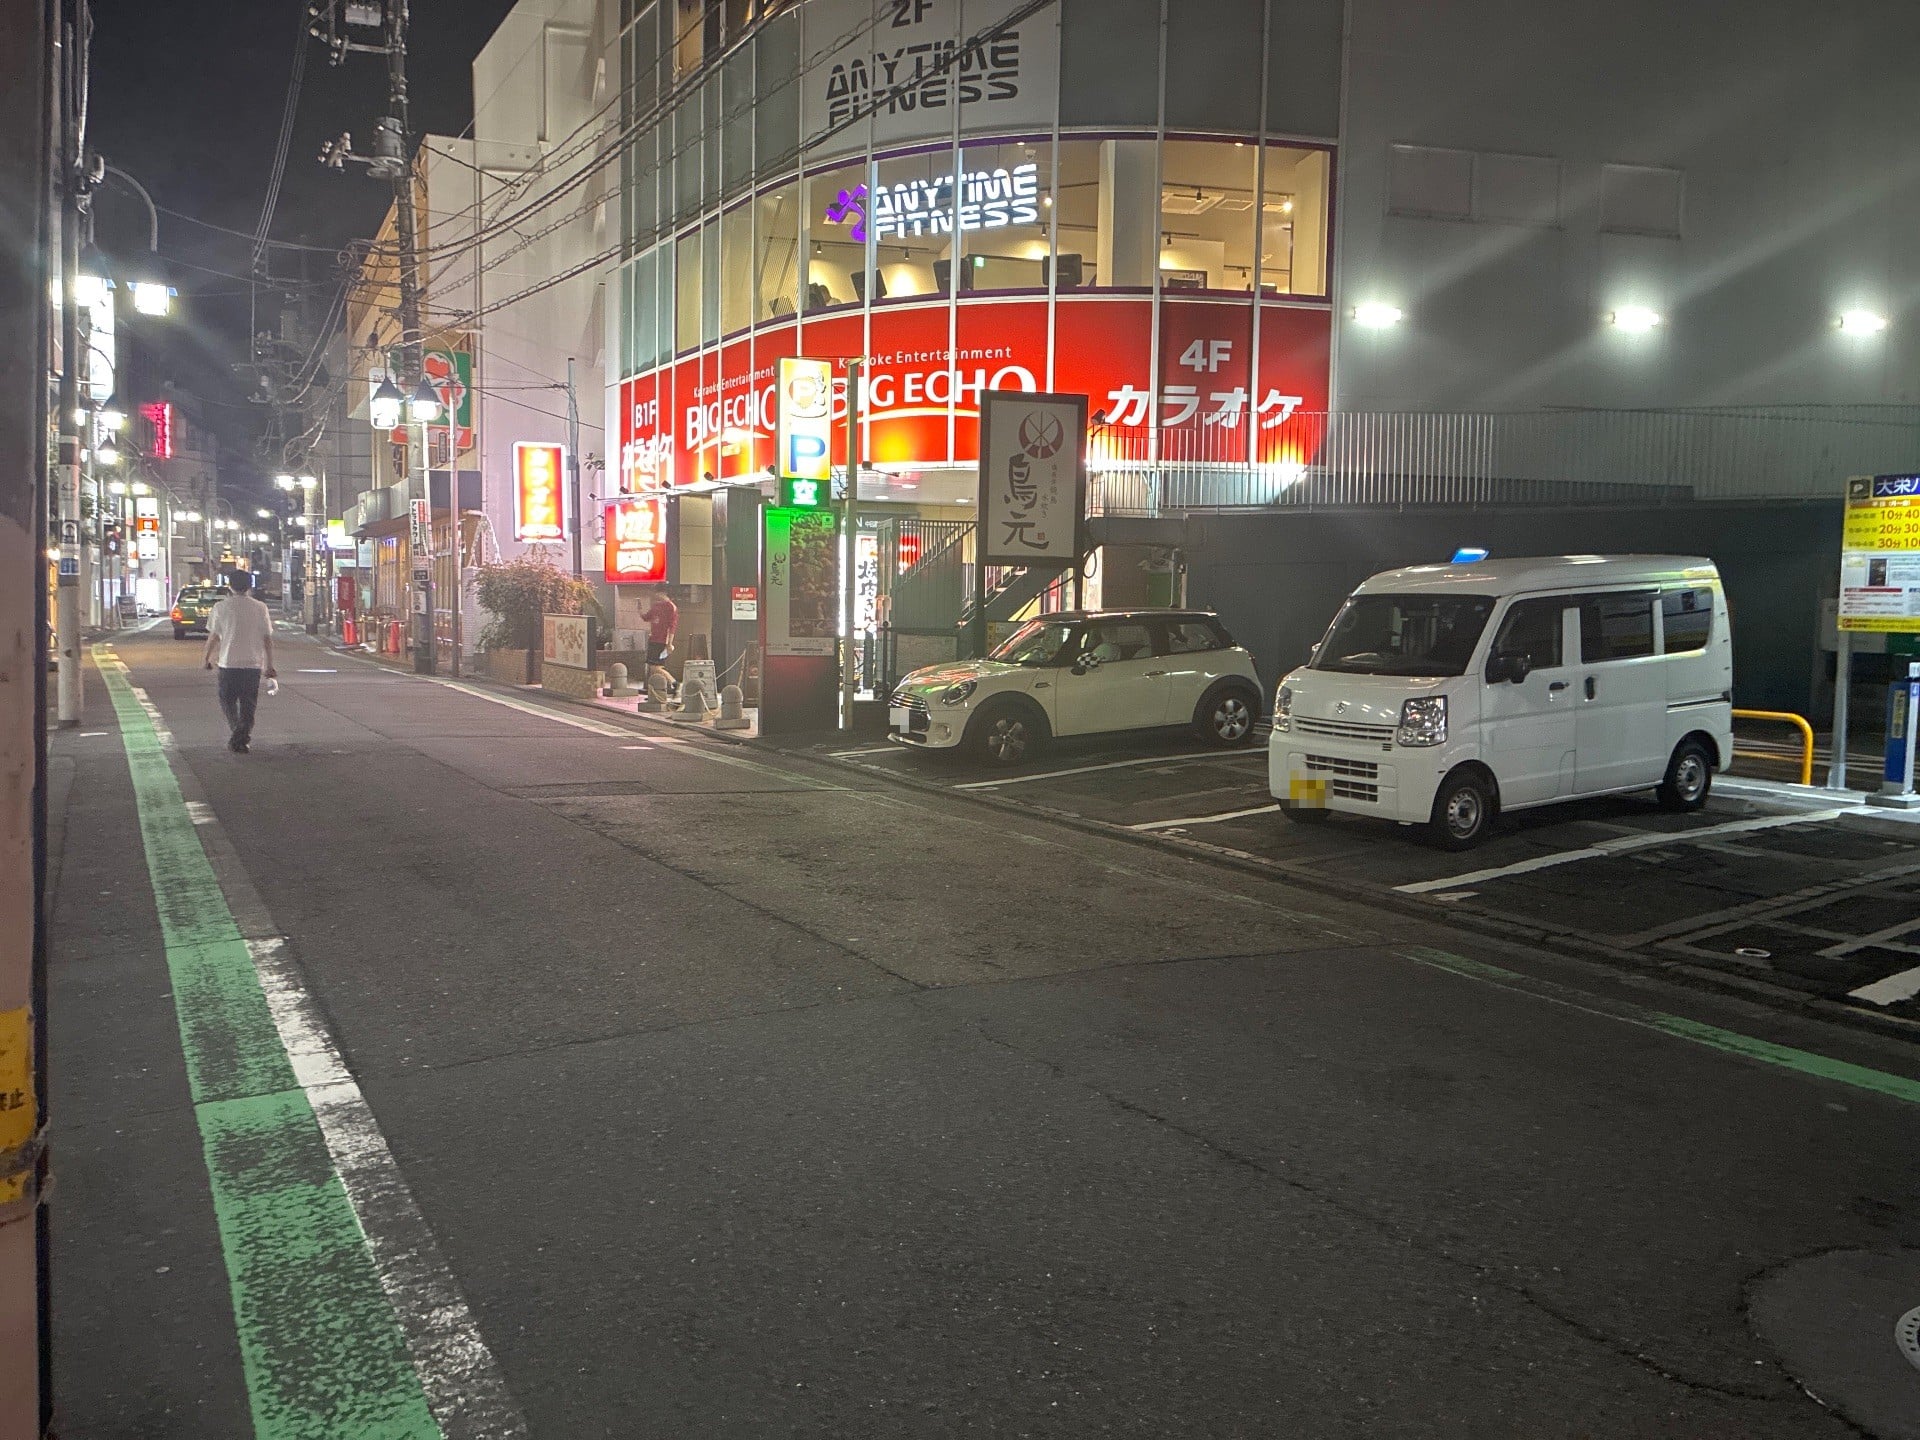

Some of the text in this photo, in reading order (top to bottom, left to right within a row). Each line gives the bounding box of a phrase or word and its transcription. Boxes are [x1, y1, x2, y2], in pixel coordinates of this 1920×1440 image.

[826, 31, 1019, 100] ANYTIME
[829, 70, 1018, 128] FITNESS
[875, 163, 1037, 217] ANYTIME
[875, 197, 1038, 241] FITNESS
[896, 346, 1012, 364] Entertainment
[1179, 339, 1232, 373] 4F
[635, 400, 657, 429] B1F
[1105, 384, 1303, 430] カラオケ
[790, 434, 826, 473] P
[1003, 453, 1050, 550] 鳥元
[1876, 477, 1920, 495] 大栄
